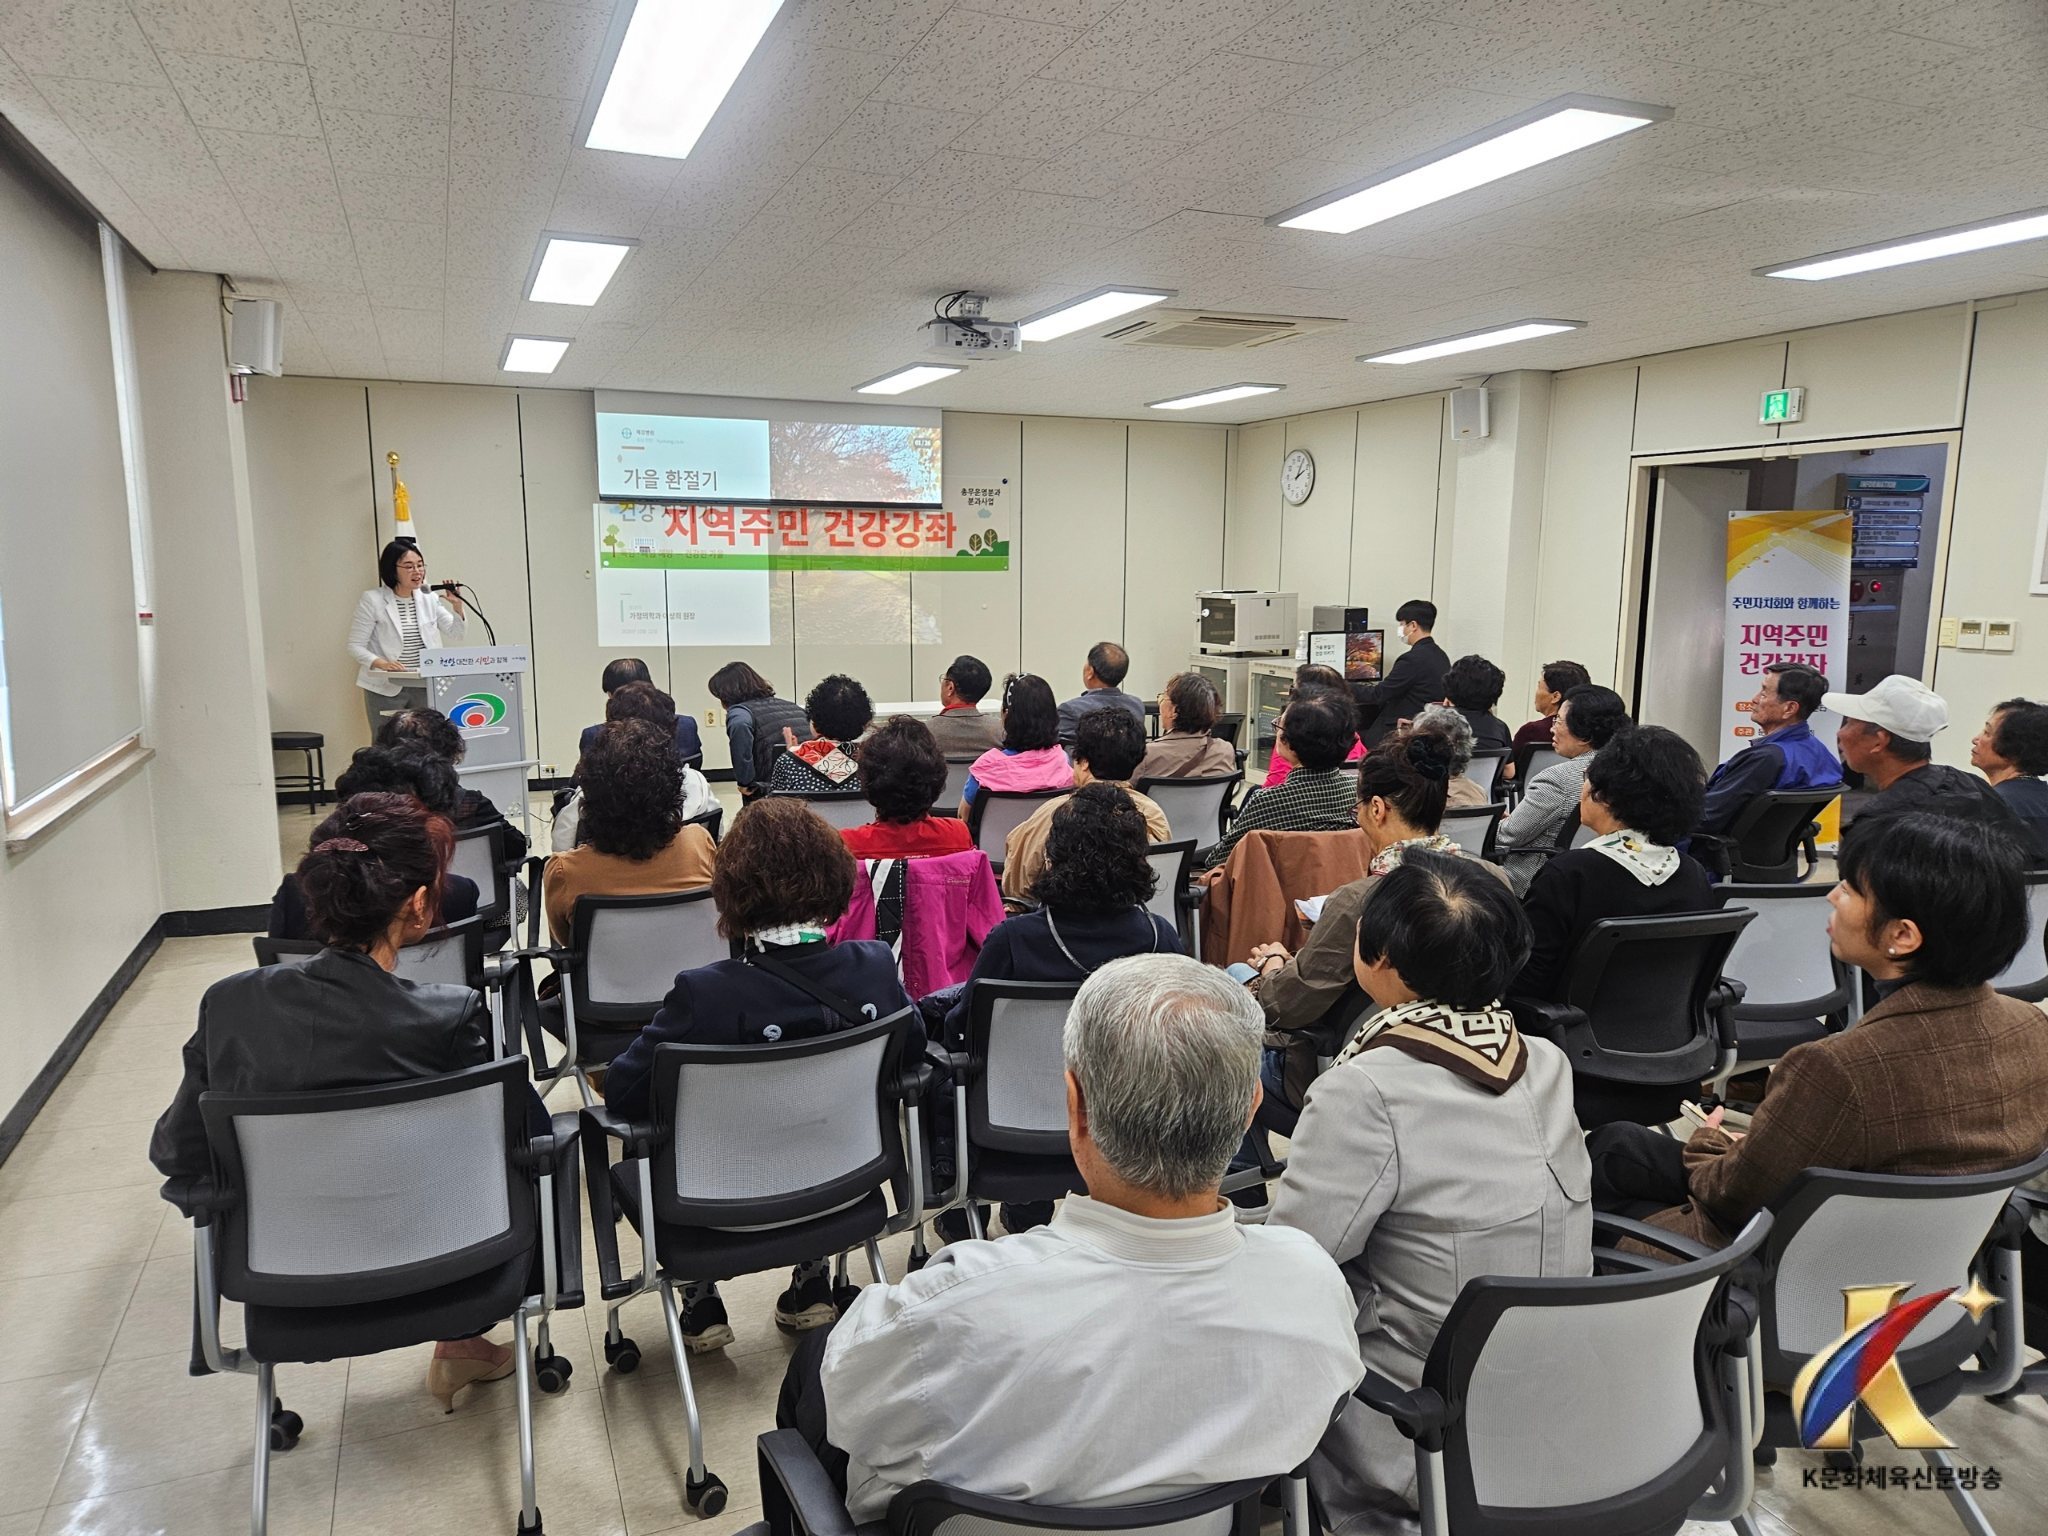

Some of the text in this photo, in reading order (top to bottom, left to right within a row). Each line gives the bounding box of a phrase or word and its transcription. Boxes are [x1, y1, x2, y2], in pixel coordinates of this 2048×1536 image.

[623, 468, 717, 492] 가을 환절기
[619, 500, 656, 523] 건강
[967, 497, 995, 507] 분과사업
[664, 502, 957, 549] 지역주민 건강강좌
[1732, 596, 1841, 610] 주민자치회와 함께하는
[1740, 624, 1828, 648] 지역주민
